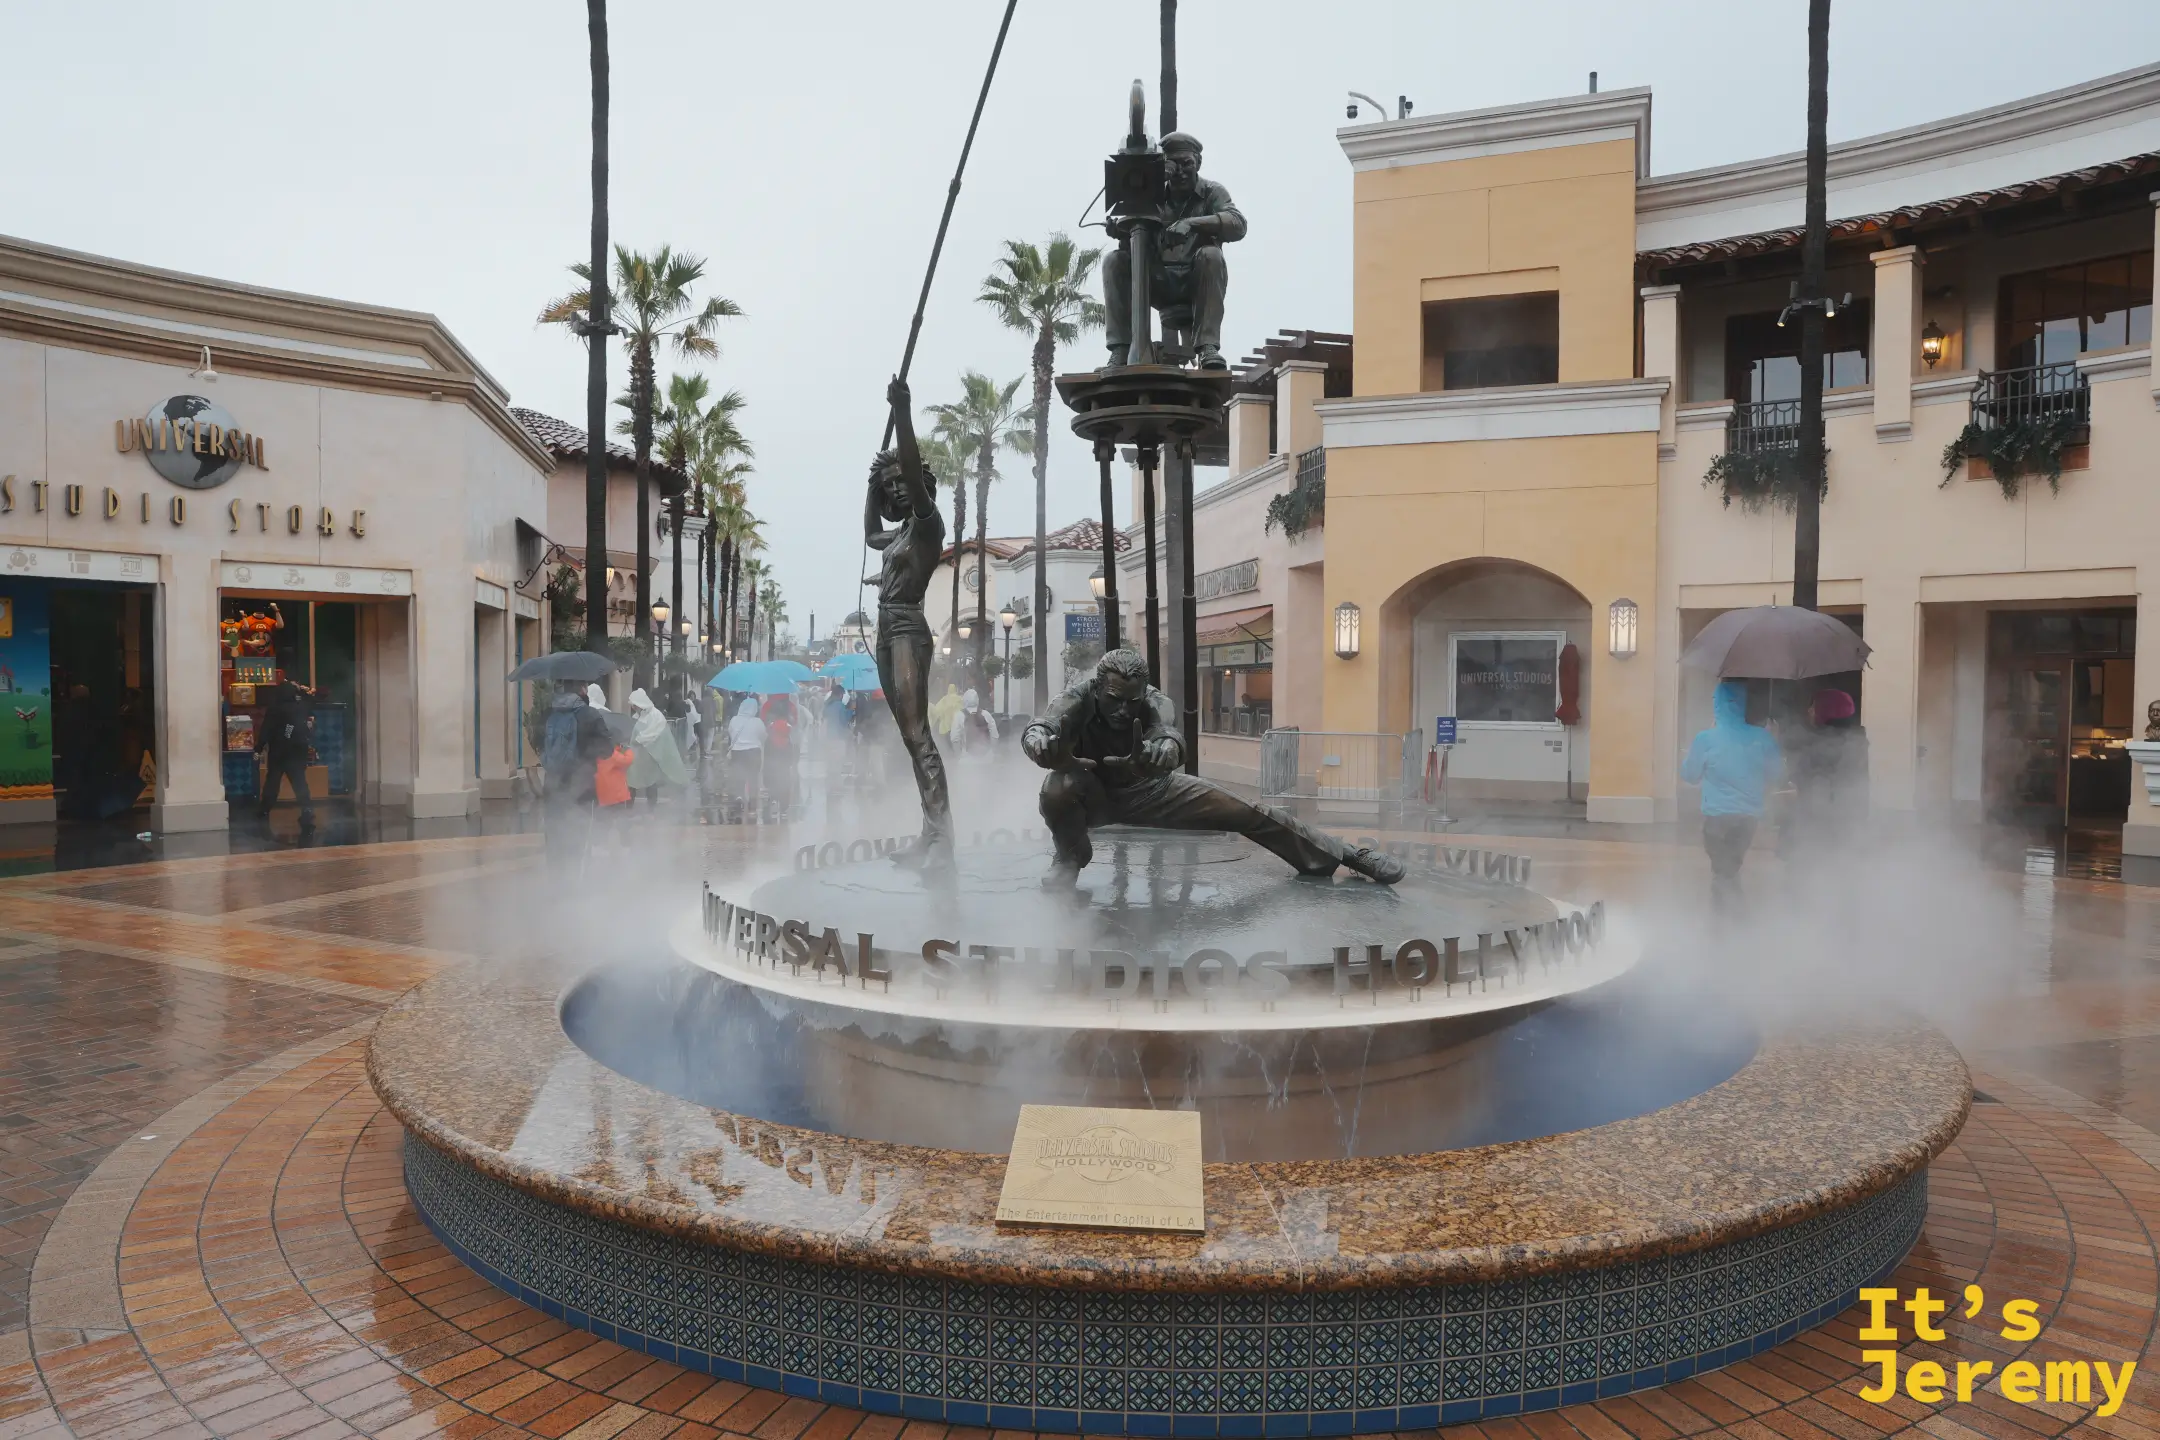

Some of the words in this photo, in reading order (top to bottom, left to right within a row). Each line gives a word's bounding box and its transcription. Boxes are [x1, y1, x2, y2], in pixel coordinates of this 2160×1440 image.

[116, 418, 269, 472] UNIVERSAL
[1, 474, 187, 525] STUDIO
[227, 499, 366, 538] STORE
[1460, 671, 1511, 684] UNIVERSAL
[1514, 671, 1553, 685] STUDIOS
[1036, 1137, 1115, 1157] UNIVERSAL
[1119, 1138, 1175, 1163] STUDIOS
[1054, 1157, 1157, 1171] HOLLYWOOD
[1000, 1207, 1021, 1219] The
[1025, 1209, 1109, 1223] Entertainment
[1113, 1213, 1155, 1226] Capital
[1160, 1215, 1171, 1226] of
